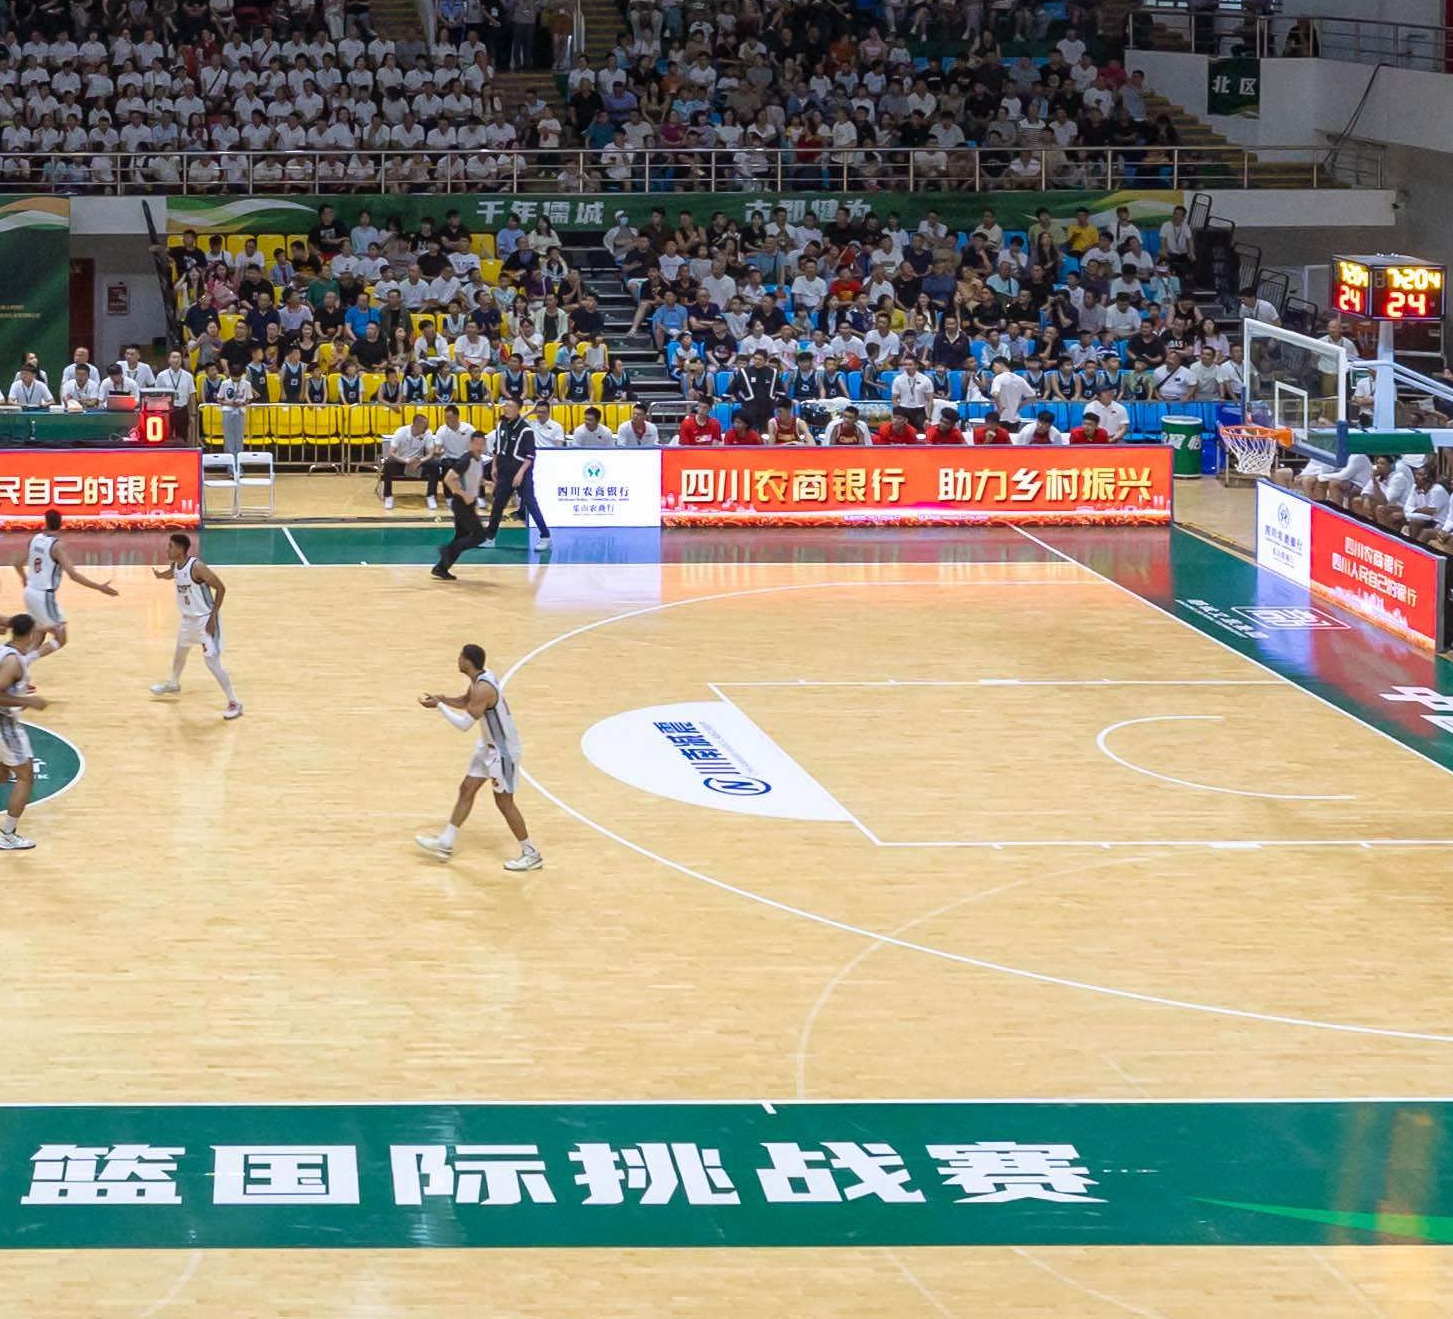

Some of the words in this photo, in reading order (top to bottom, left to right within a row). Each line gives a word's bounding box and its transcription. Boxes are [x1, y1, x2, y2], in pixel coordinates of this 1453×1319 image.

[1212, 75, 1257, 96] 北区
[476, 200, 606, 225] 千年儒城
[1339, 285, 1361, 312] 24
[1385, 291, 1426, 318] 24
[145, 416, 164, 442] 0
[557, 486, 630, 497] 四川农商银行
[680, 468, 907, 503] 四川农商银行
[938, 467, 1153, 503] 助力乡村振兴
